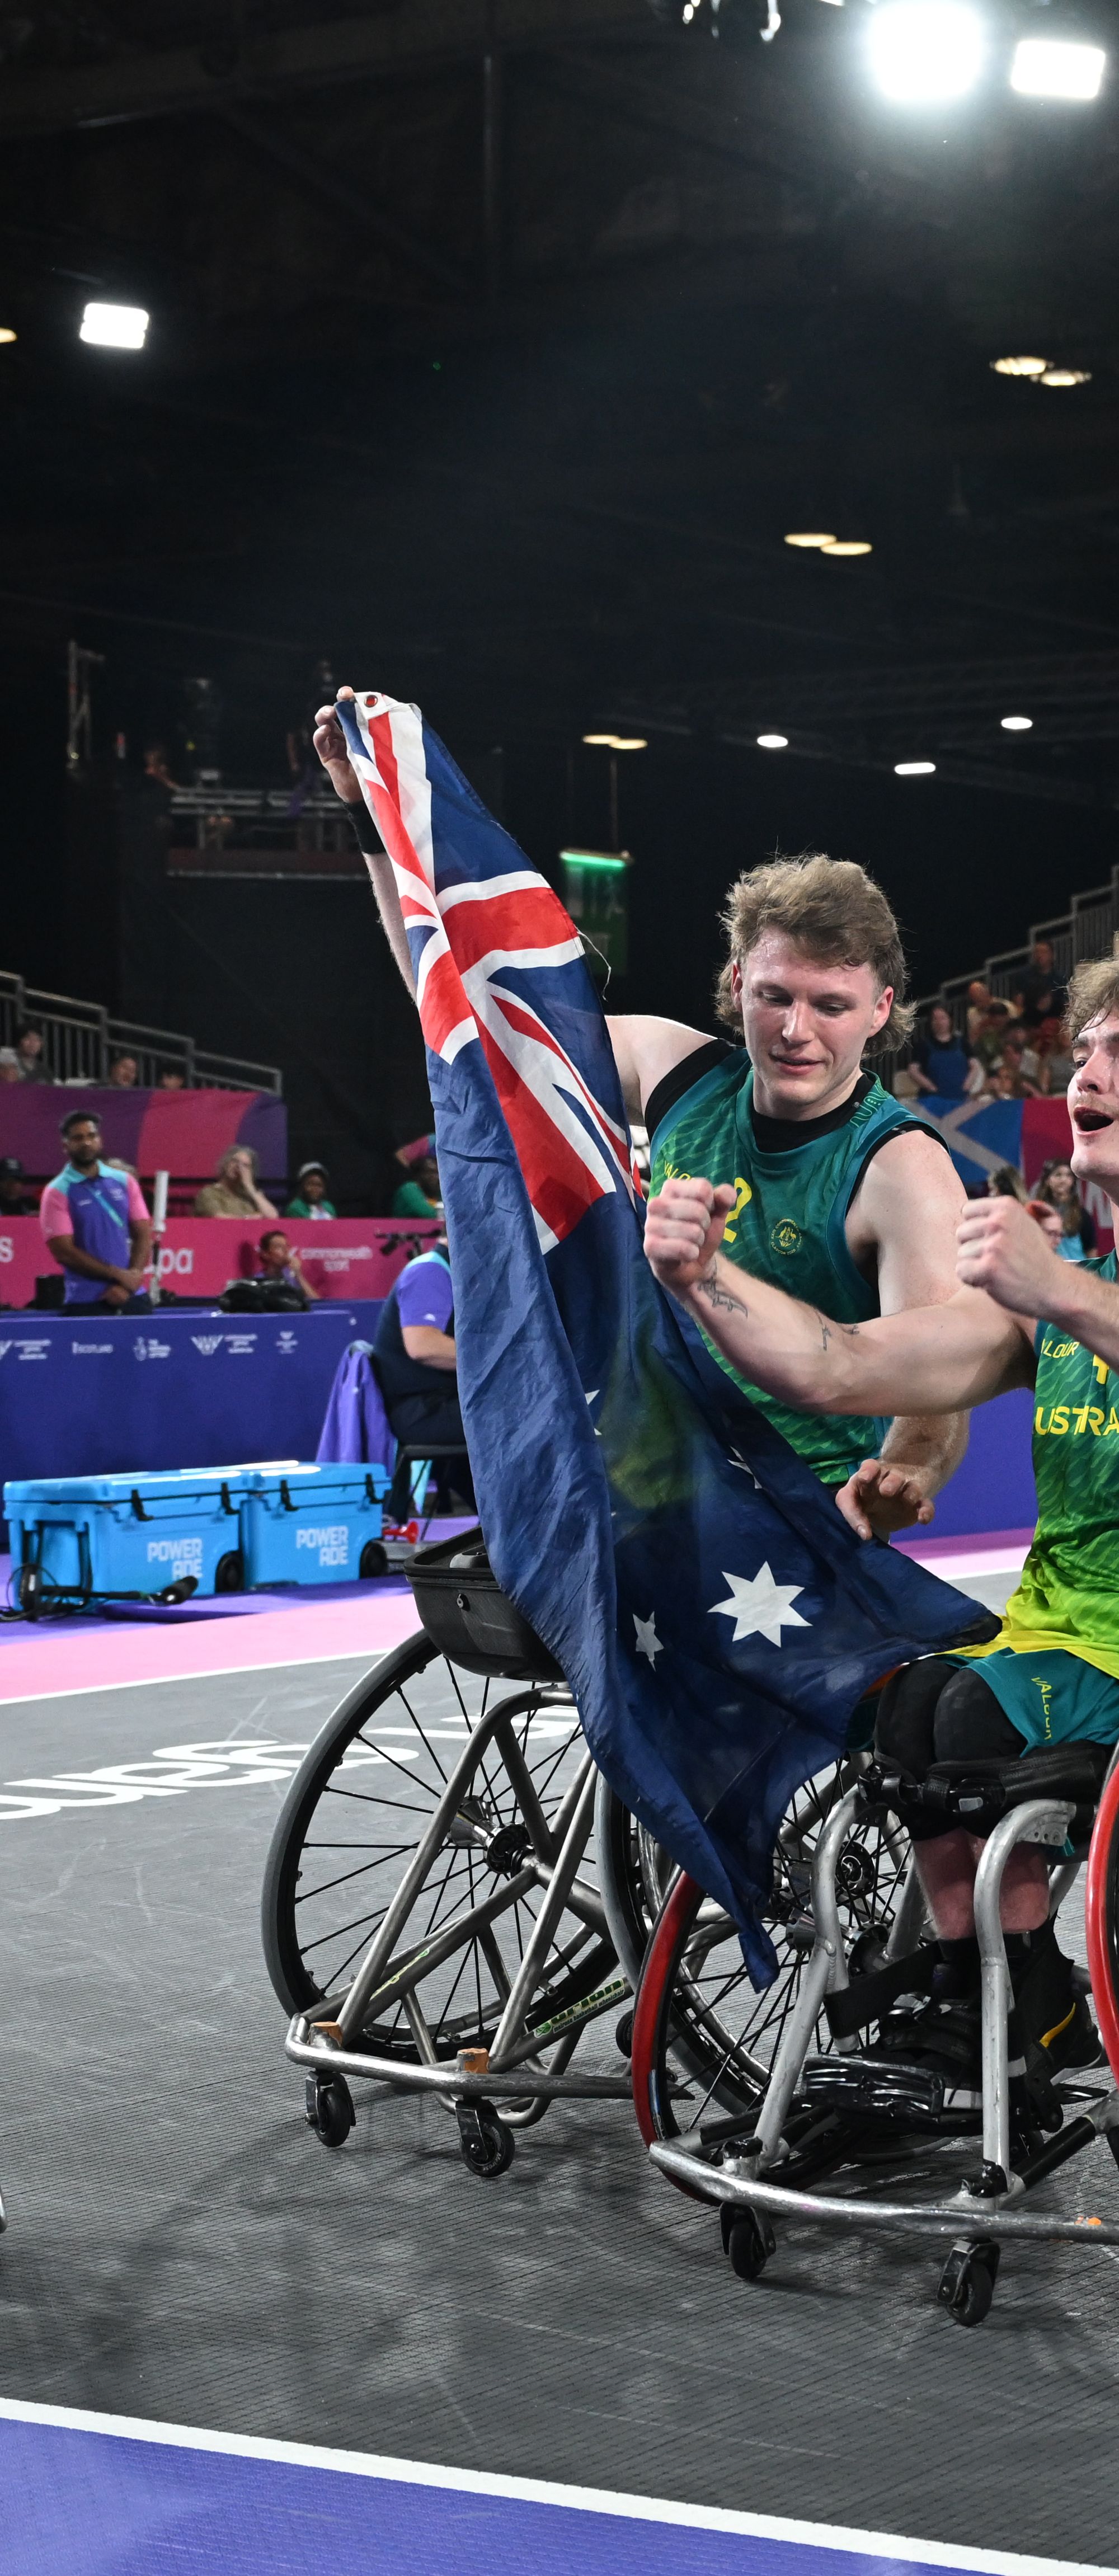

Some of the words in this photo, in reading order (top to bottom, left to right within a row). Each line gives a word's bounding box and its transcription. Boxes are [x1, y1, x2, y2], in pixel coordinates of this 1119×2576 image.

[295, 1525, 349, 1549] POWER
[147, 1537, 203, 1563] POWER
[319, 1546, 349, 1567] ADE
[172, 1558, 203, 1581] ADE
